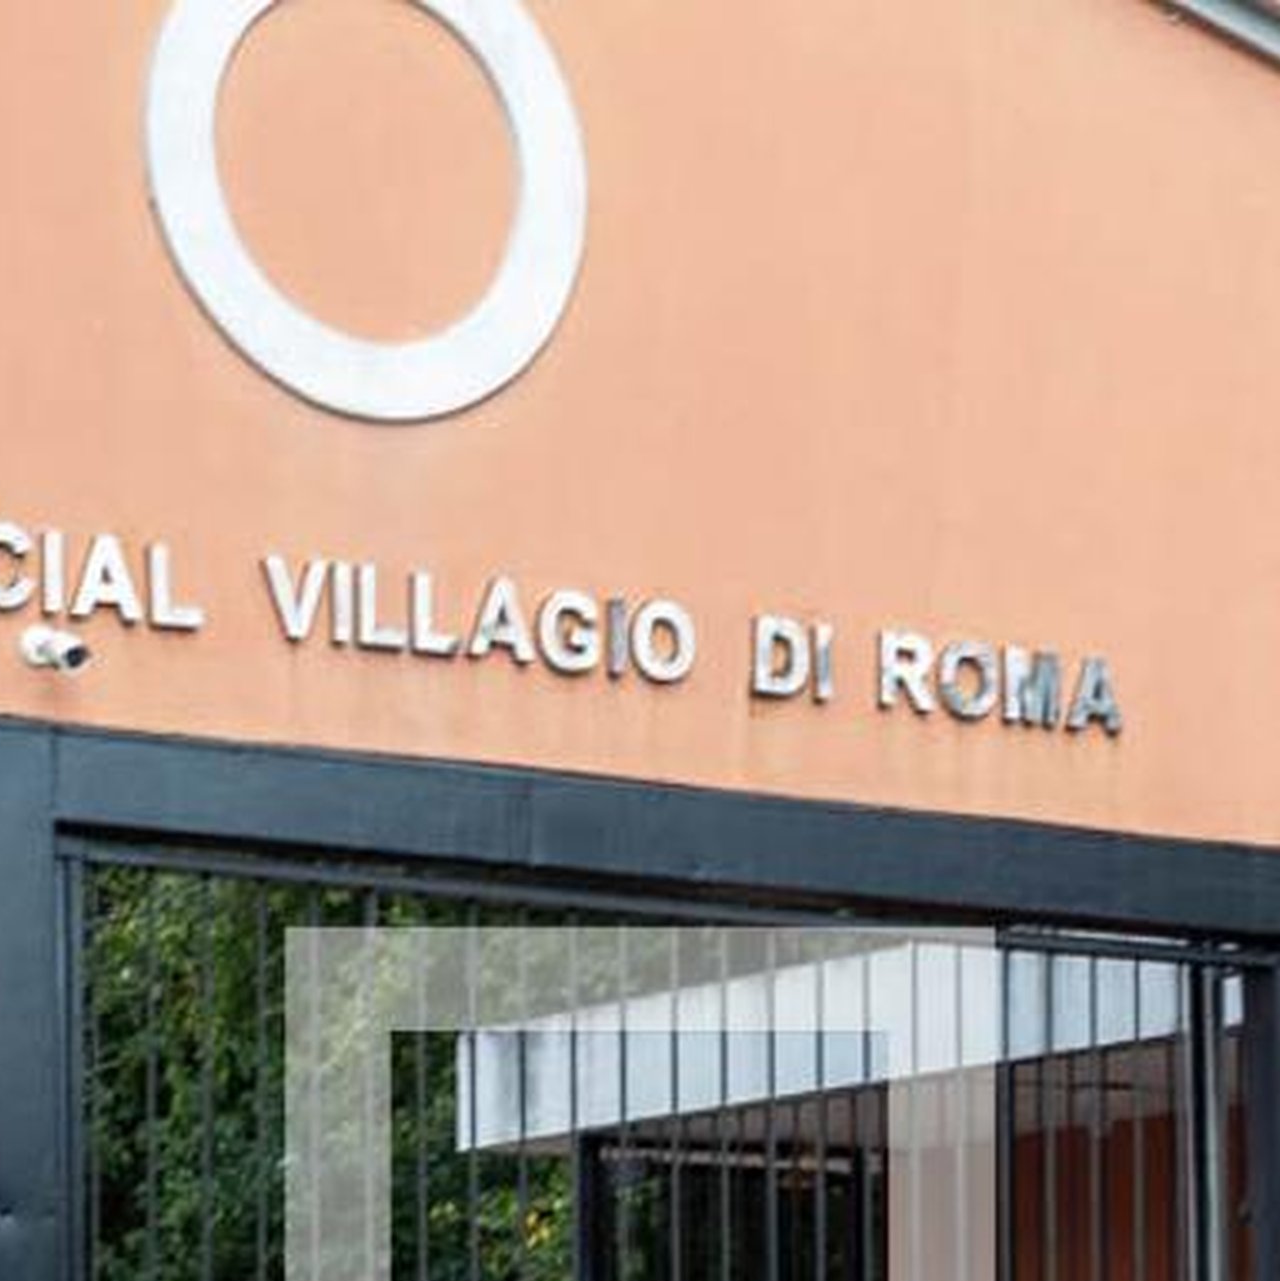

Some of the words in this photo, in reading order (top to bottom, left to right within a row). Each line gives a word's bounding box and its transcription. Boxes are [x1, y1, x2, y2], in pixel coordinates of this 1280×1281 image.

[263, 553, 697, 684] VILLAGIO
[750, 612, 836, 702] DI
[877, 627, 1124, 734] ROMA
